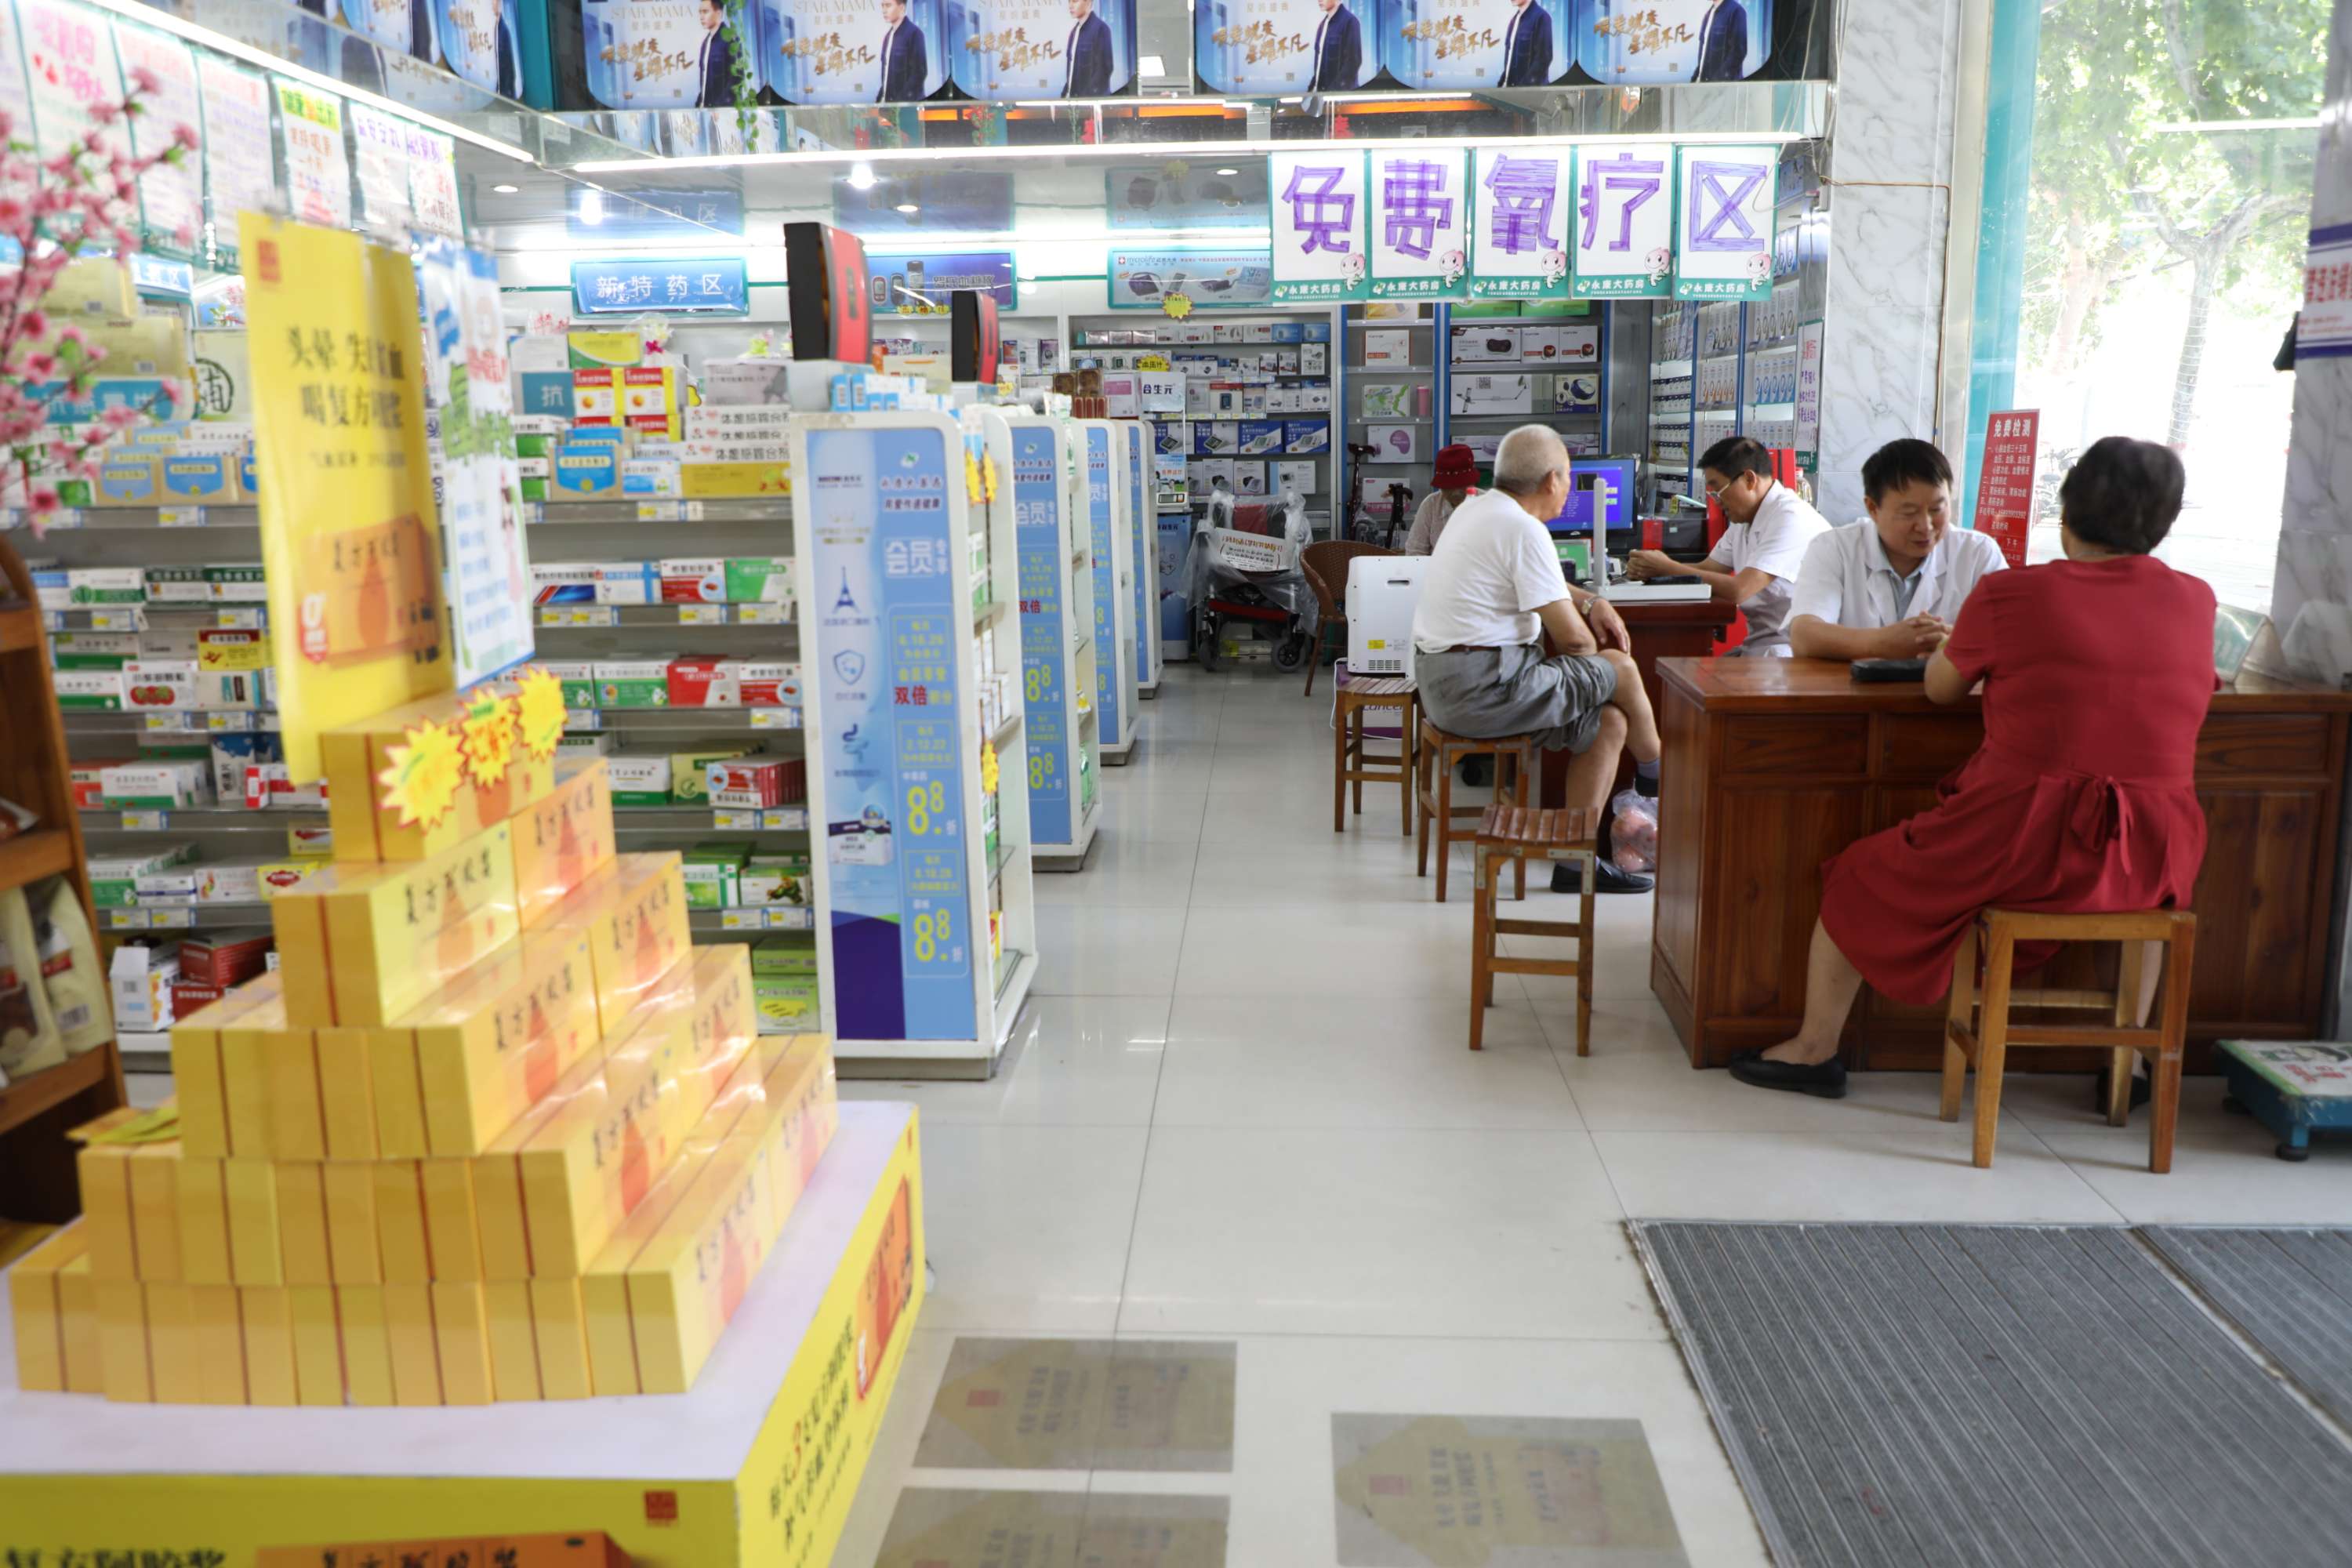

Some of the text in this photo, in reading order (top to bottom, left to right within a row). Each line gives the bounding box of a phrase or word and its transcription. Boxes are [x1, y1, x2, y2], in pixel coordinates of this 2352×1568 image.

[1281, 152, 1767, 261] 免费氧疗区
[596, 274, 723, 299] 新特药区
[1387, 281, 1439, 292] 永康大药房
[1488, 281, 1540, 291] 永康大药房
[1592, 279, 1644, 289] 永康大药房
[1693, 282, 1745, 292] 永康大药房
[1289, 285, 1341, 295] 永康大药房
[1143, 384, 1174, 395] 合生元
[1994, 417, 2032, 437] 免费检测
[1016, 502, 1046, 525] 会员
[885, 538, 934, 575] 会员
